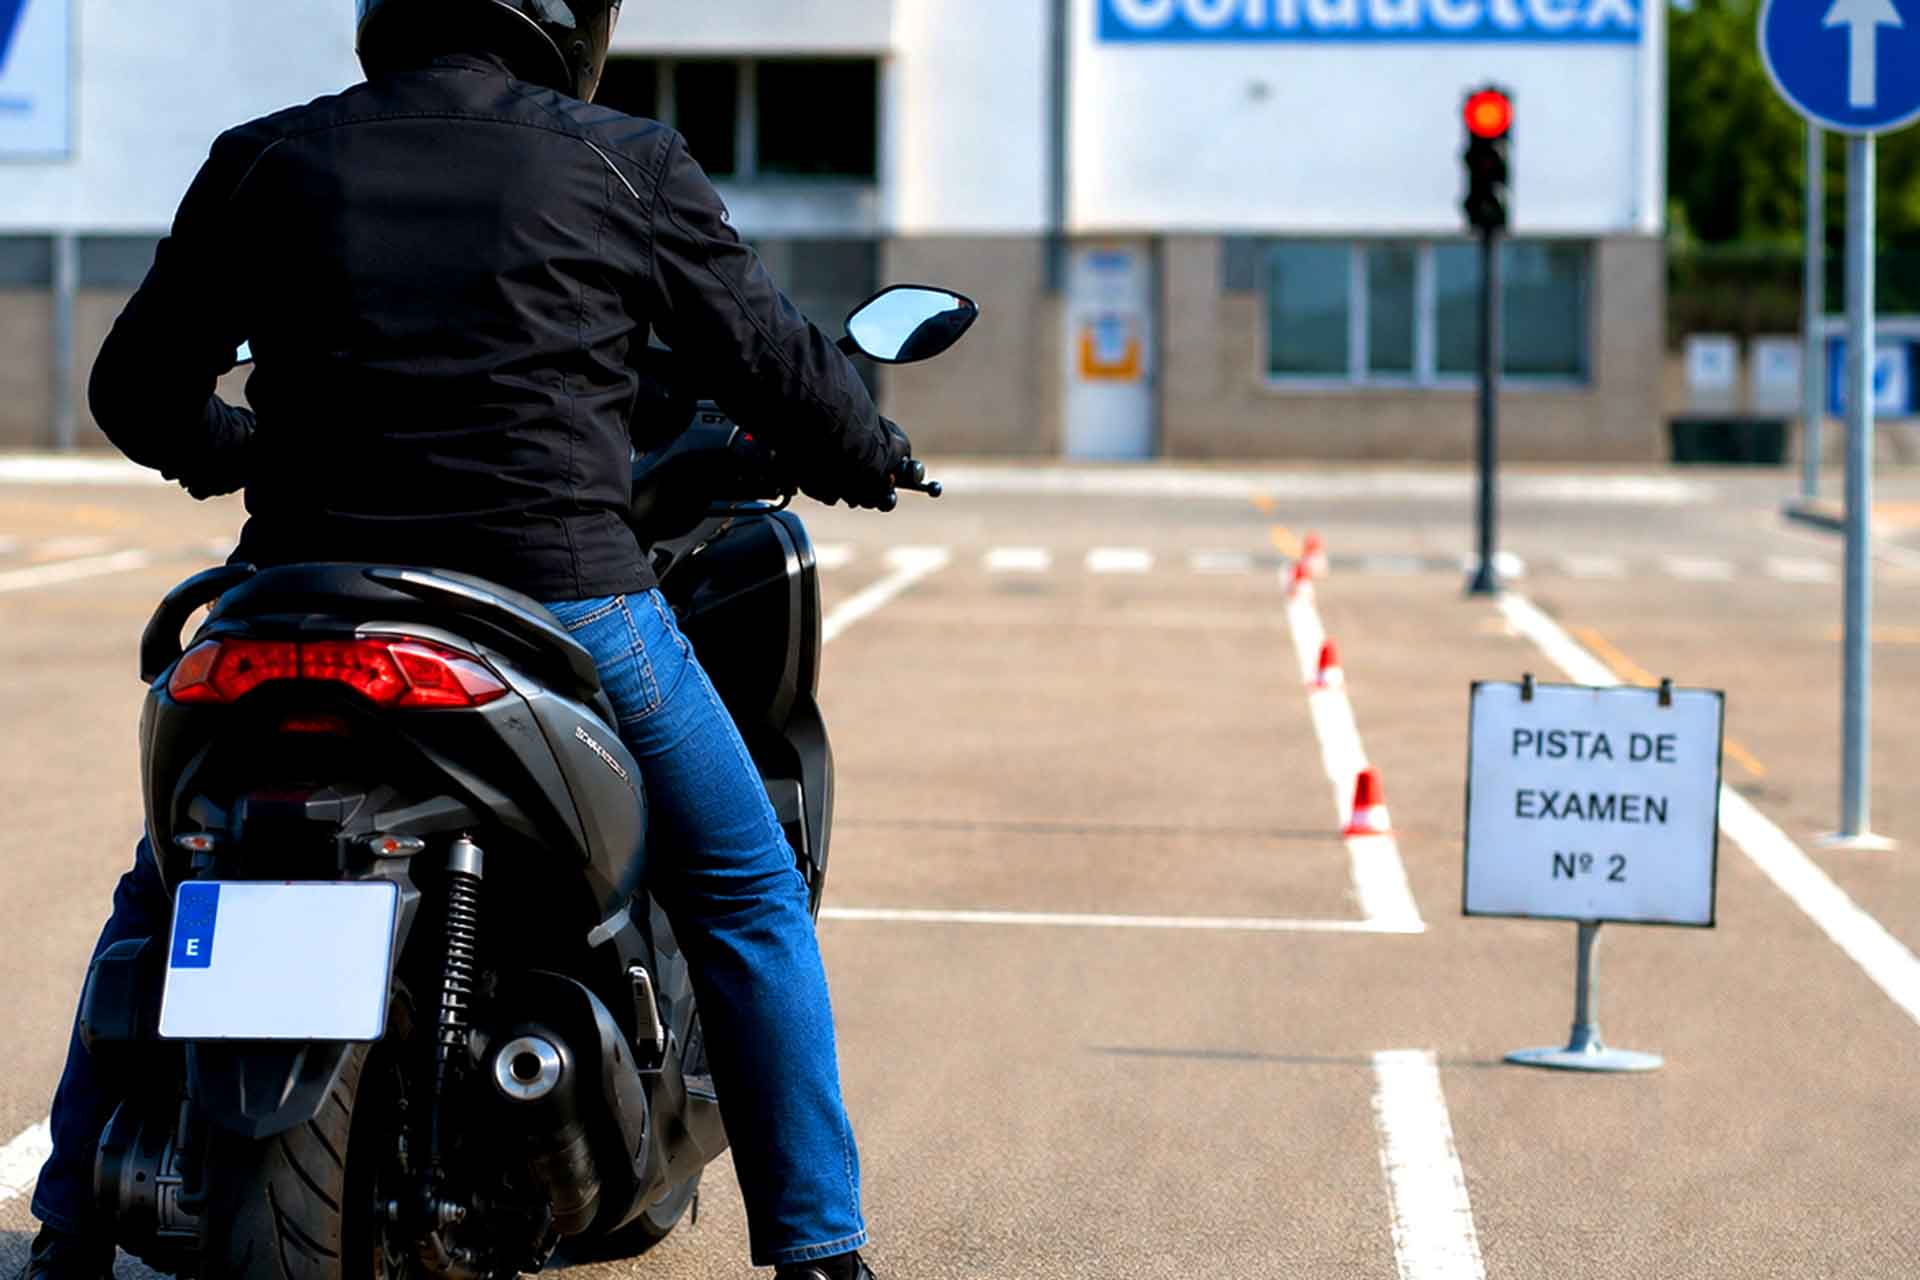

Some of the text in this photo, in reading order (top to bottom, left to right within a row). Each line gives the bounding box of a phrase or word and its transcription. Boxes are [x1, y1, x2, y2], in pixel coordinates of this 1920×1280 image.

[1511, 728, 1678, 764] PISTA DE
[1515, 789, 1668, 825] EXAMEN
[1607, 854, 1627, 883] 2
[185, 938, 200, 956] E
